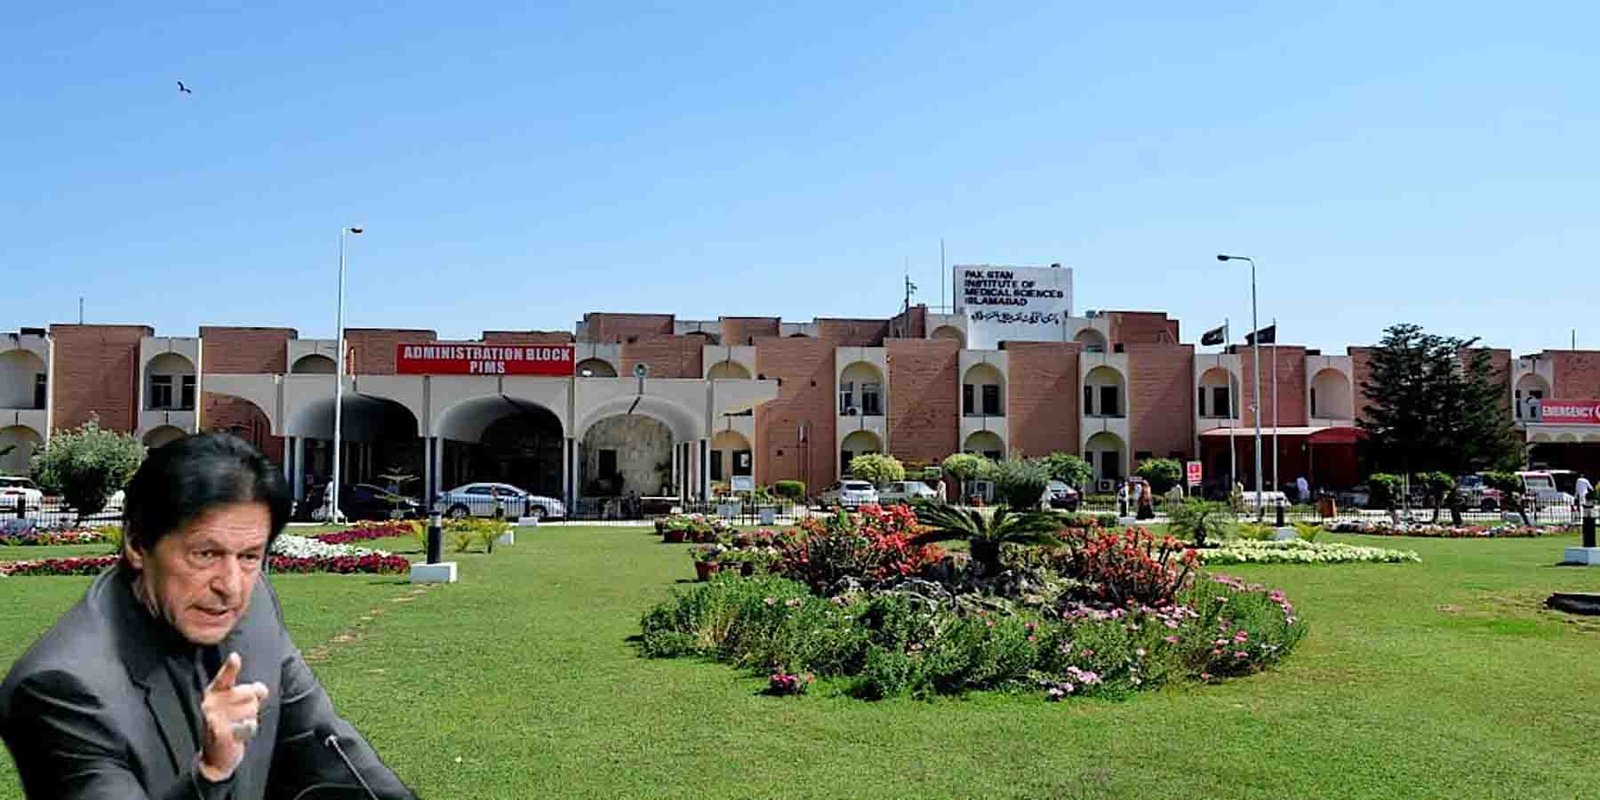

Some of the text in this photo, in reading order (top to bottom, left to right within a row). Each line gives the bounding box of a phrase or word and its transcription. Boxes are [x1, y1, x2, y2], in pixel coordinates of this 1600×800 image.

[965, 270, 1013, 279] PAKSTAN
[964, 280, 1017, 288] INSTITUTE
[965, 288, 1064, 298] MEDICAL SCIENCES
[964, 297, 1028, 306] ISLAMABAD
[403, 347, 570, 361] ADMINISTRATION BLOCK
[469, 361, 506, 373] PIMS
